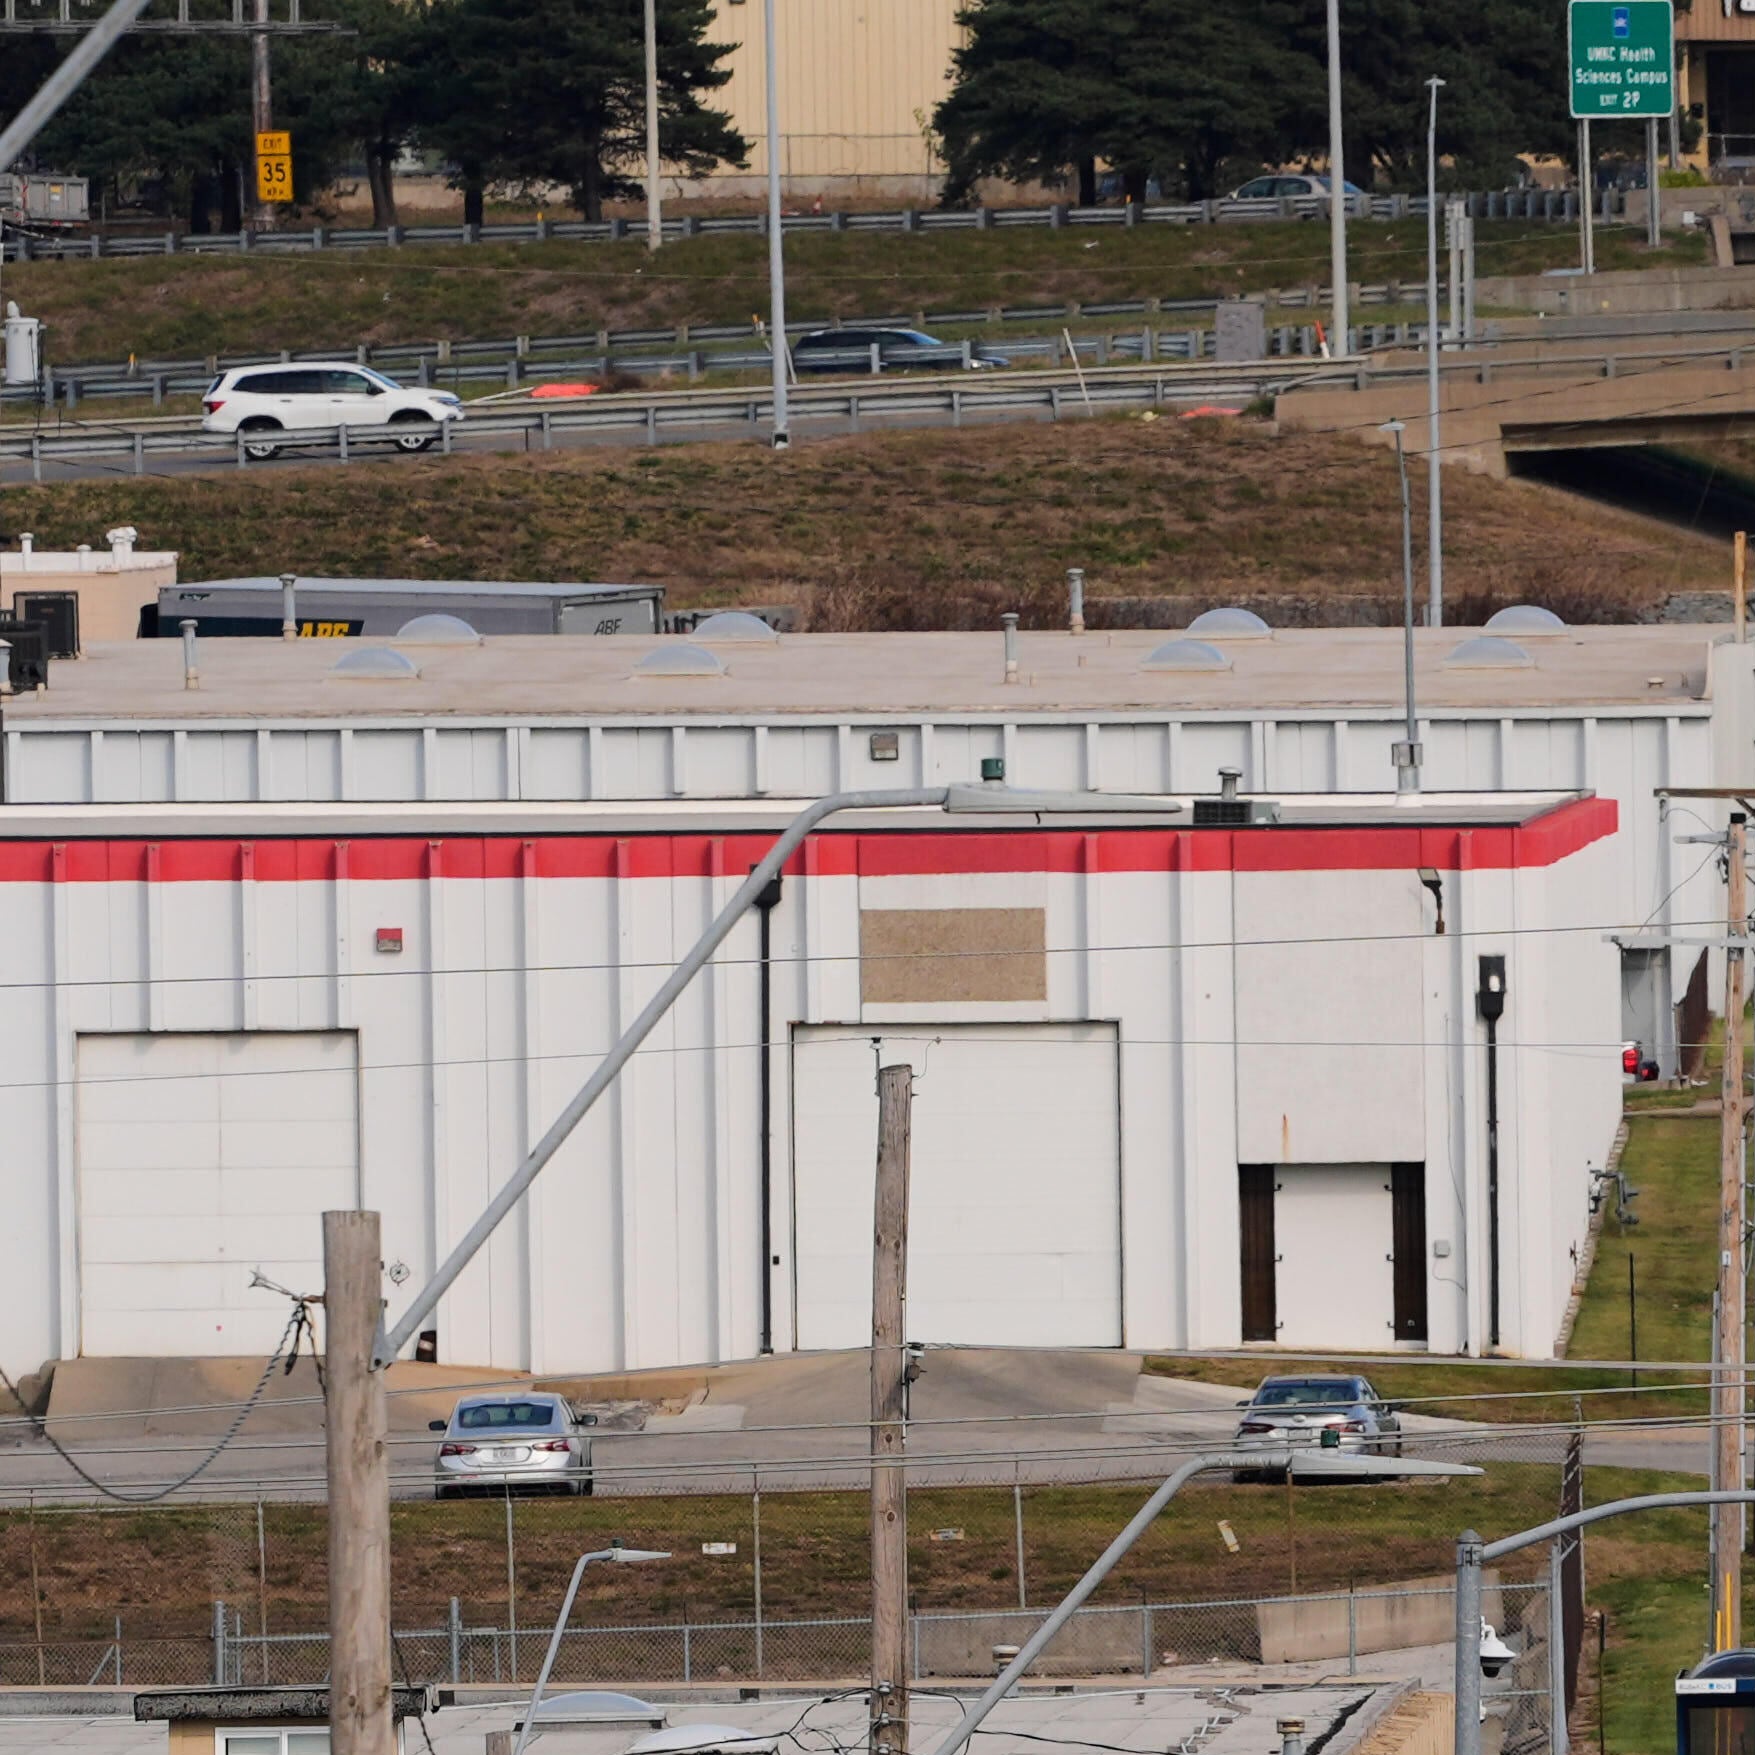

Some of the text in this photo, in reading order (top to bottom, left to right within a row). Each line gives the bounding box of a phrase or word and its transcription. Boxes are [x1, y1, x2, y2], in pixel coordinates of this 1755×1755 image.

[1620, 47, 1655, 62] Health
[1576, 68, 1668, 86] Sciences Campus
[263, 162, 286, 183] 35
[593, 618, 622, 636] ABF
